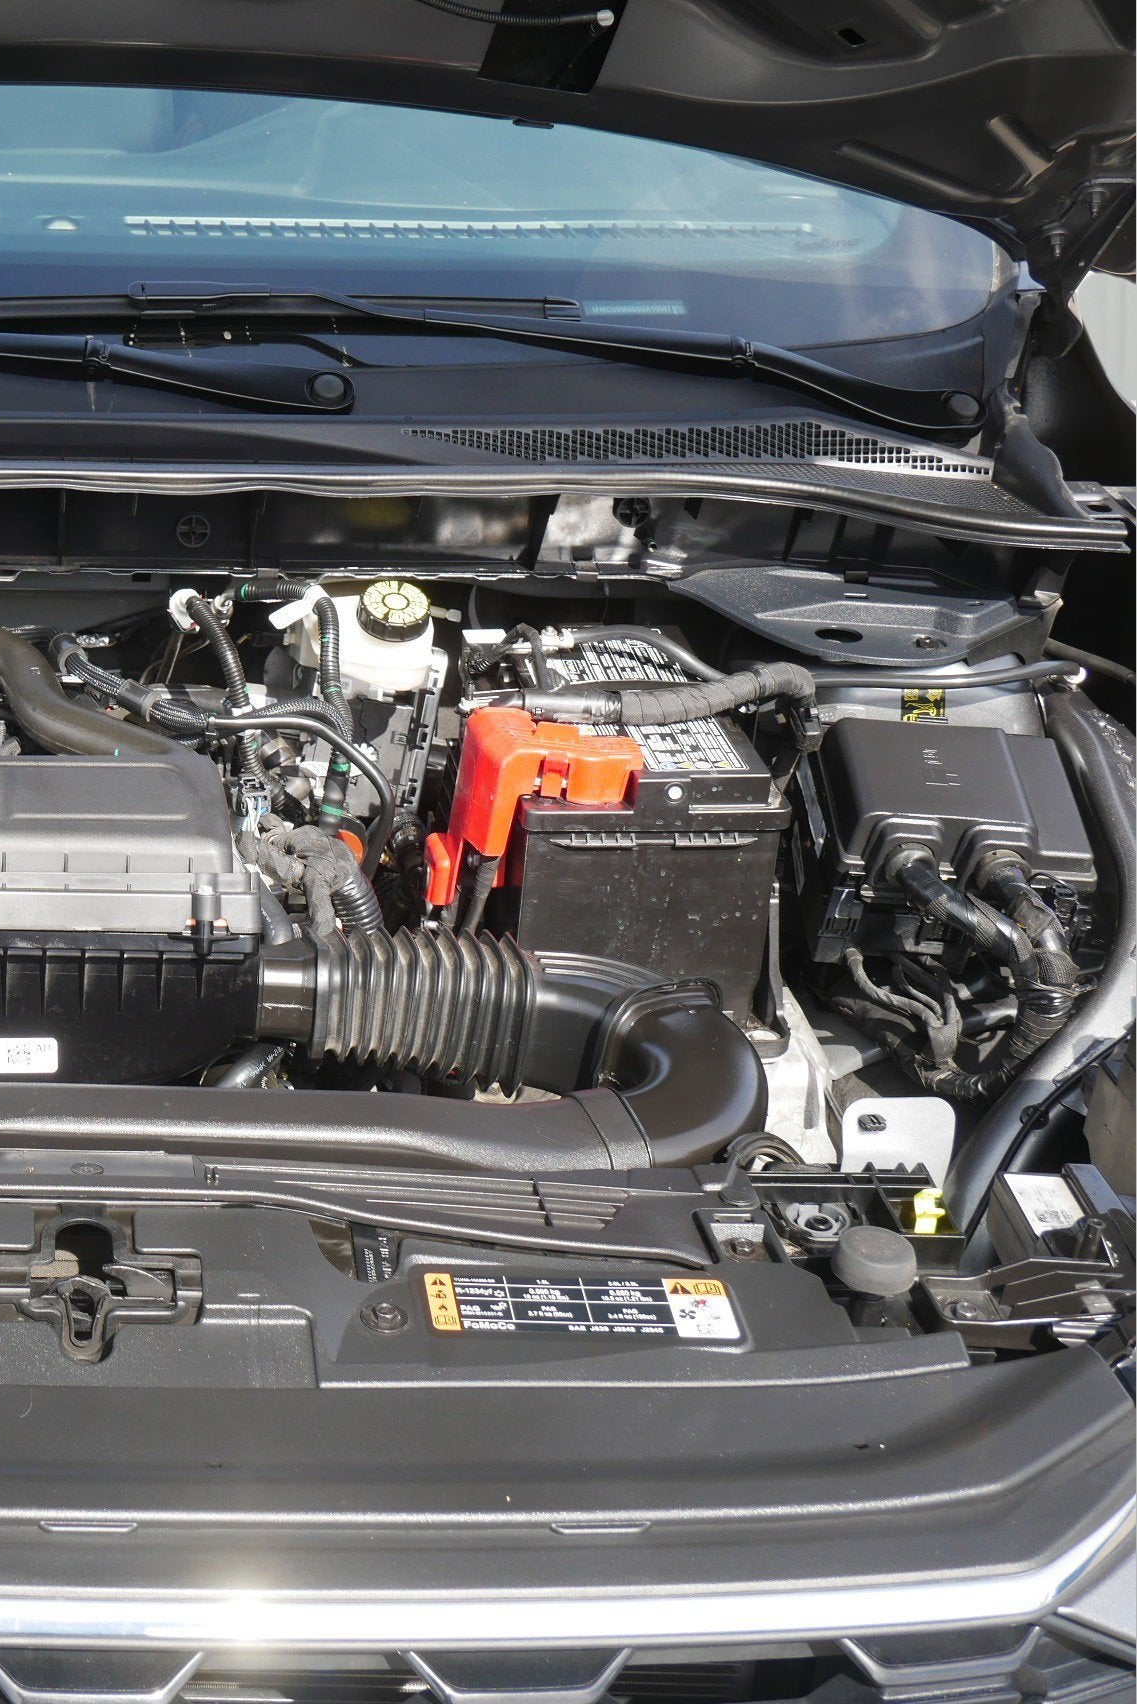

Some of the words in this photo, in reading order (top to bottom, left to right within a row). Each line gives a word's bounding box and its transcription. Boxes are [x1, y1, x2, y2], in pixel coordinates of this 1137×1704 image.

[454, 1287, 493, 1296] R-1234yf
[549, 1289, 562, 1297] kg
[630, 1290, 642, 1298] kg
[459, 1304, 481, 1312] PAG
[463, 1320, 516, 1330] FoMoCo
